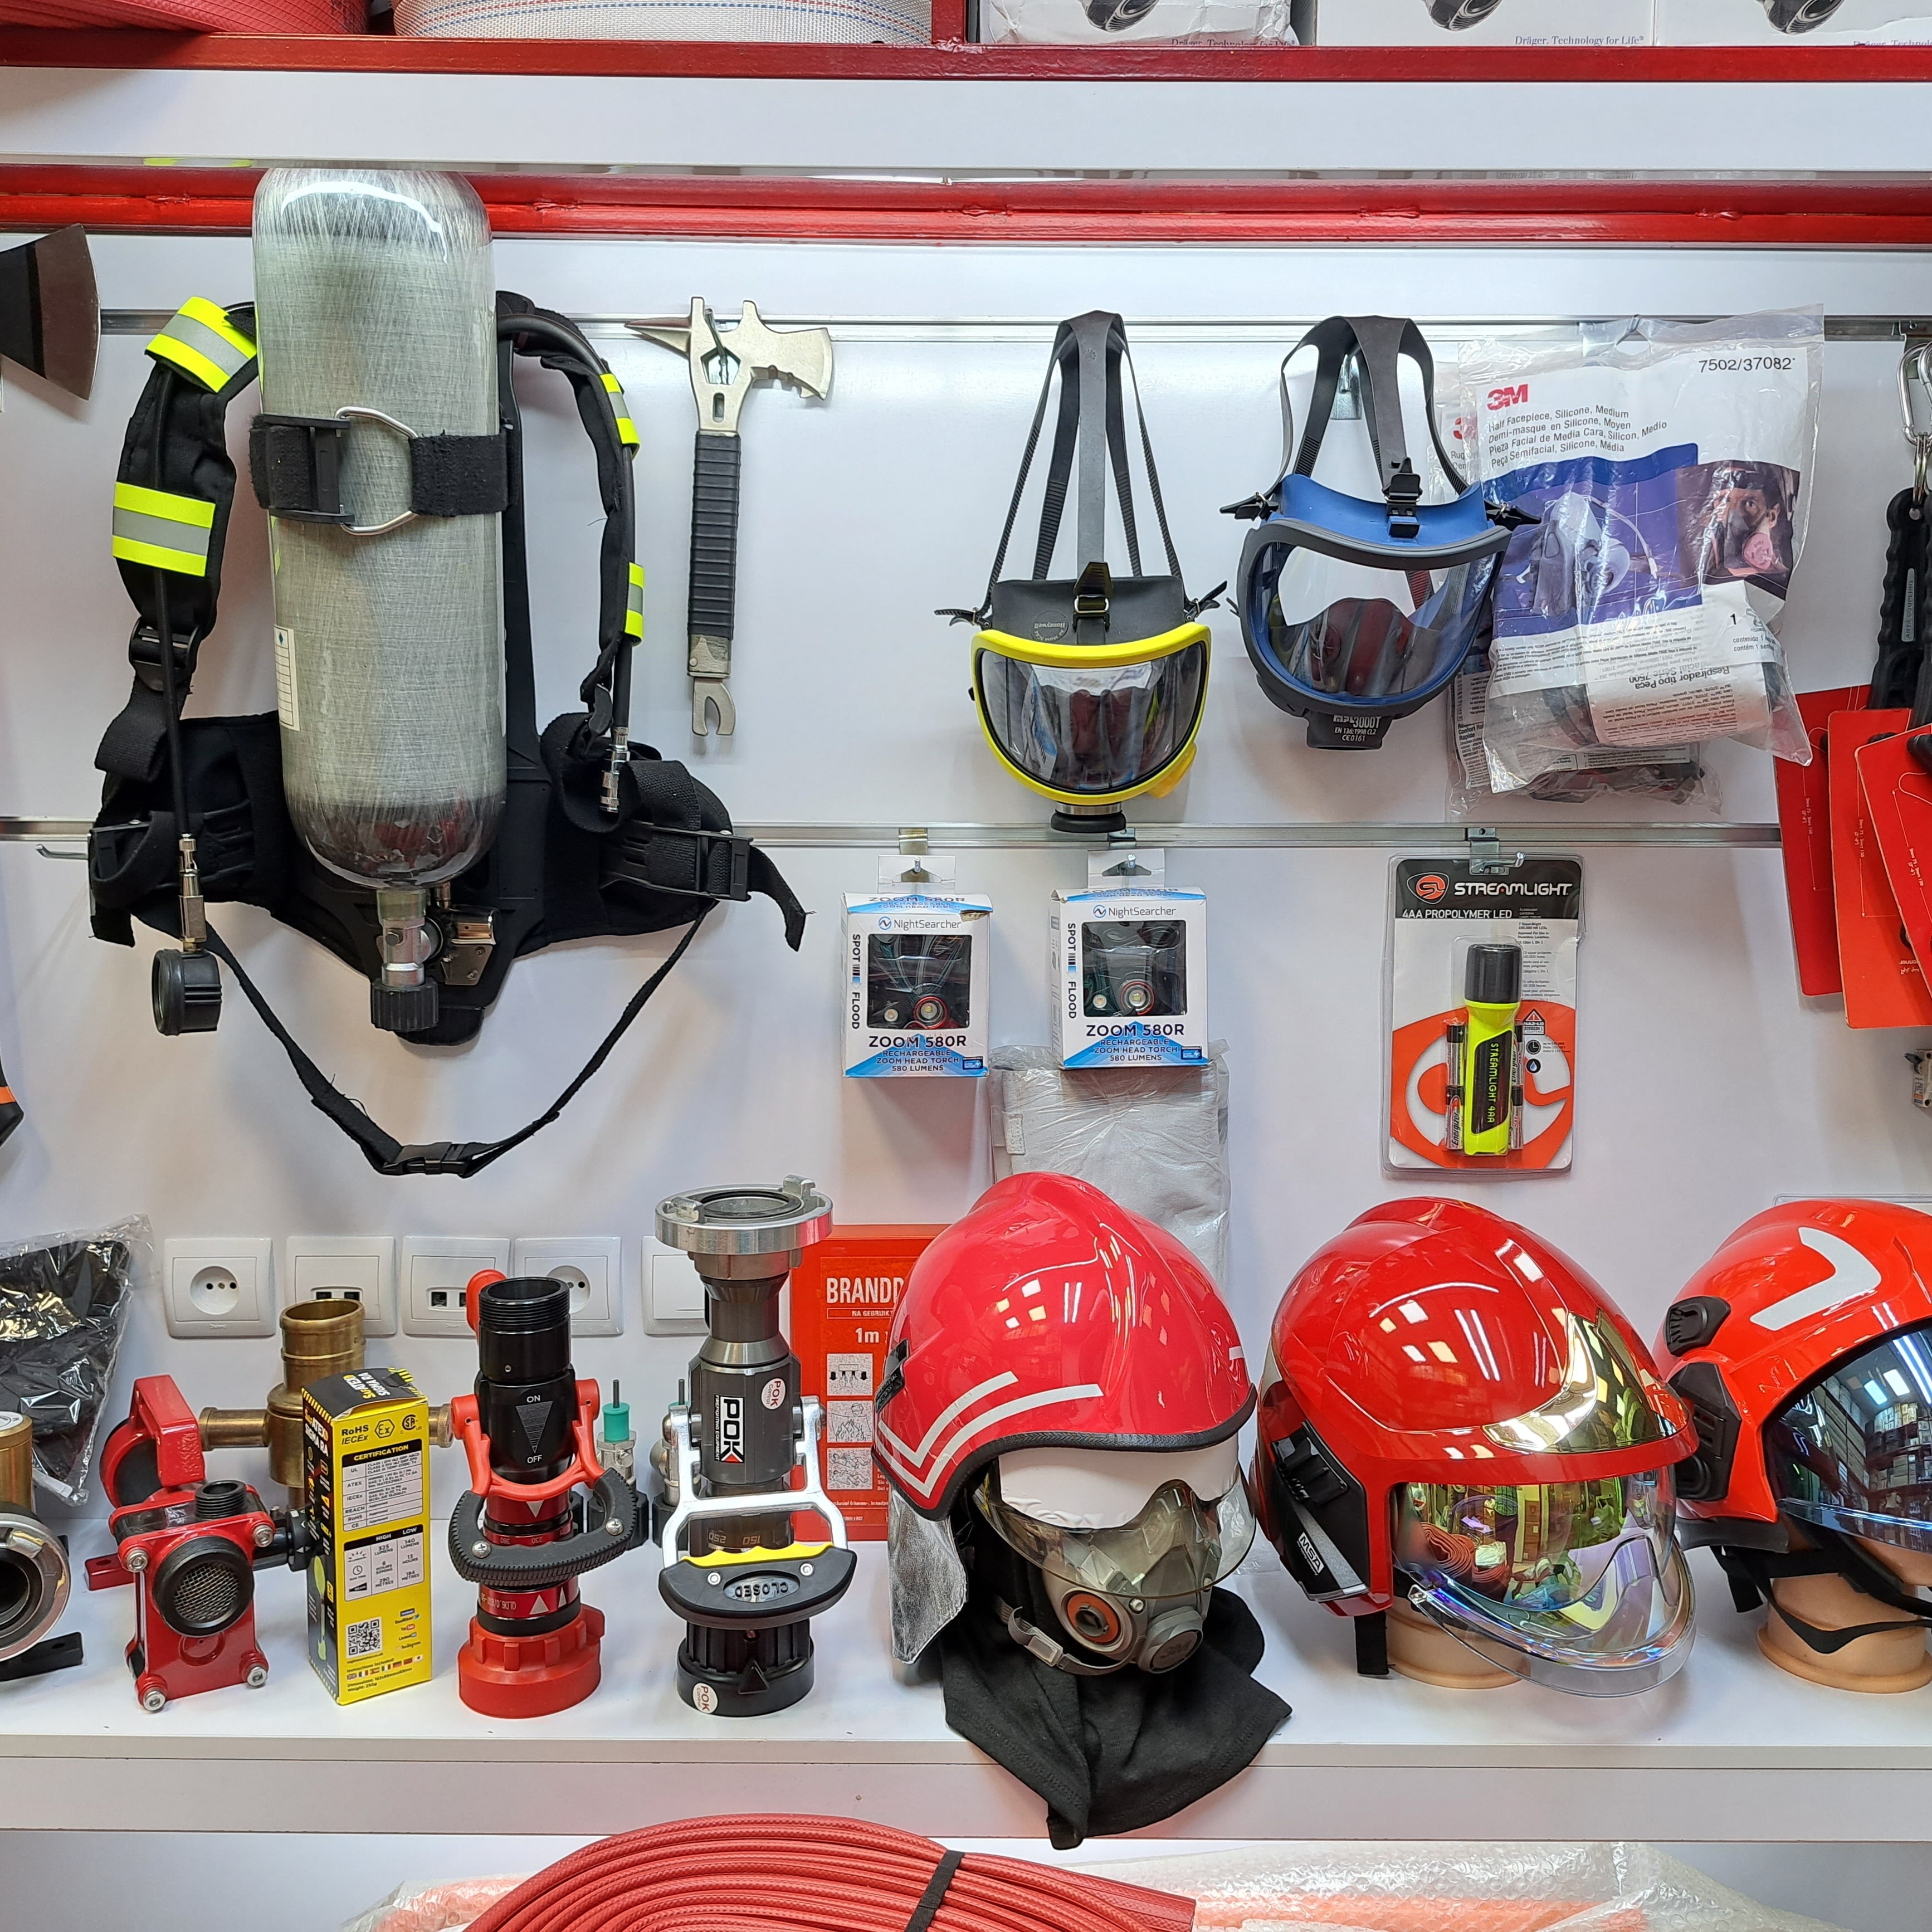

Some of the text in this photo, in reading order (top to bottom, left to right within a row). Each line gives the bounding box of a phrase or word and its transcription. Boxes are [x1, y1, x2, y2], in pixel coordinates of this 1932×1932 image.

[1515, 36, 1549, 46] Dräger.
[1552, 36, 1603, 46] Technology
[1606, 36, 1619, 45] for
[1487, 384, 1528, 411] 3M
[1489, 419, 1504, 433] Half
[1507, 413, 1552, 426] Facepiece,
[1555, 407, 1592, 418] Silicone,
[1596, 405, 1628, 418] Medium
[1489, 424, 1546, 443] Demi-masque
[1564, 418, 1601, 428] Silicone,
[1604, 418, 1631, 431] Moyen
[1489, 422, 1667, 456] Pieza Facial de Media Cara, Silicon, Medio
[1491, 440, 1624, 469] Peça Semifacial, Silicone, Média
[1635, 666, 1729, 689] Respirador tipo Peça
[1353, 716, 1382, 728] 3000T
[1454, 882, 1573, 896] STREAMLIGHT
[1108, 908, 1177, 919] NightSearcher
[1402, 909, 1512, 919] 4AA PROPOLYMER LED
[894, 919, 962, 930] NightSearcher
[1067, 923, 1076, 952] SPOT
[852, 934, 861, 962] SPOT
[1068, 981, 1076, 1019] FLOOD
[851, 992, 860, 1030] FLOOD
[1086, 1023, 1185, 1037] ZOOM 580R
[869, 1035, 967, 1047] ZOOM 580R
[1487, 1043, 1499, 1123] STREAMLIGHT 4AA
[1452, 1113, 1460, 1145] Energizer
[855, 1328, 879, 1343] 1m
[526, 1395, 541, 1403] ON
[770, 1380, 781, 1407] POK
[341, 1424, 369, 1436] RoHS
[720, 1399, 744, 1462] POK
[341, 1434, 369, 1445] IECEx
[320, 1441, 329, 1457] RA
[354, 1445, 408, 1461] CERTIFICATION
[527, 1455, 543, 1463] OFF
[709, 1532, 726, 1543] 250
[743, 1535, 760, 1545] 150
[1300, 1536, 1321, 1570] MSA
[735, 1582, 788, 1598] CLOSED
[701, 1686, 710, 1711] POK
